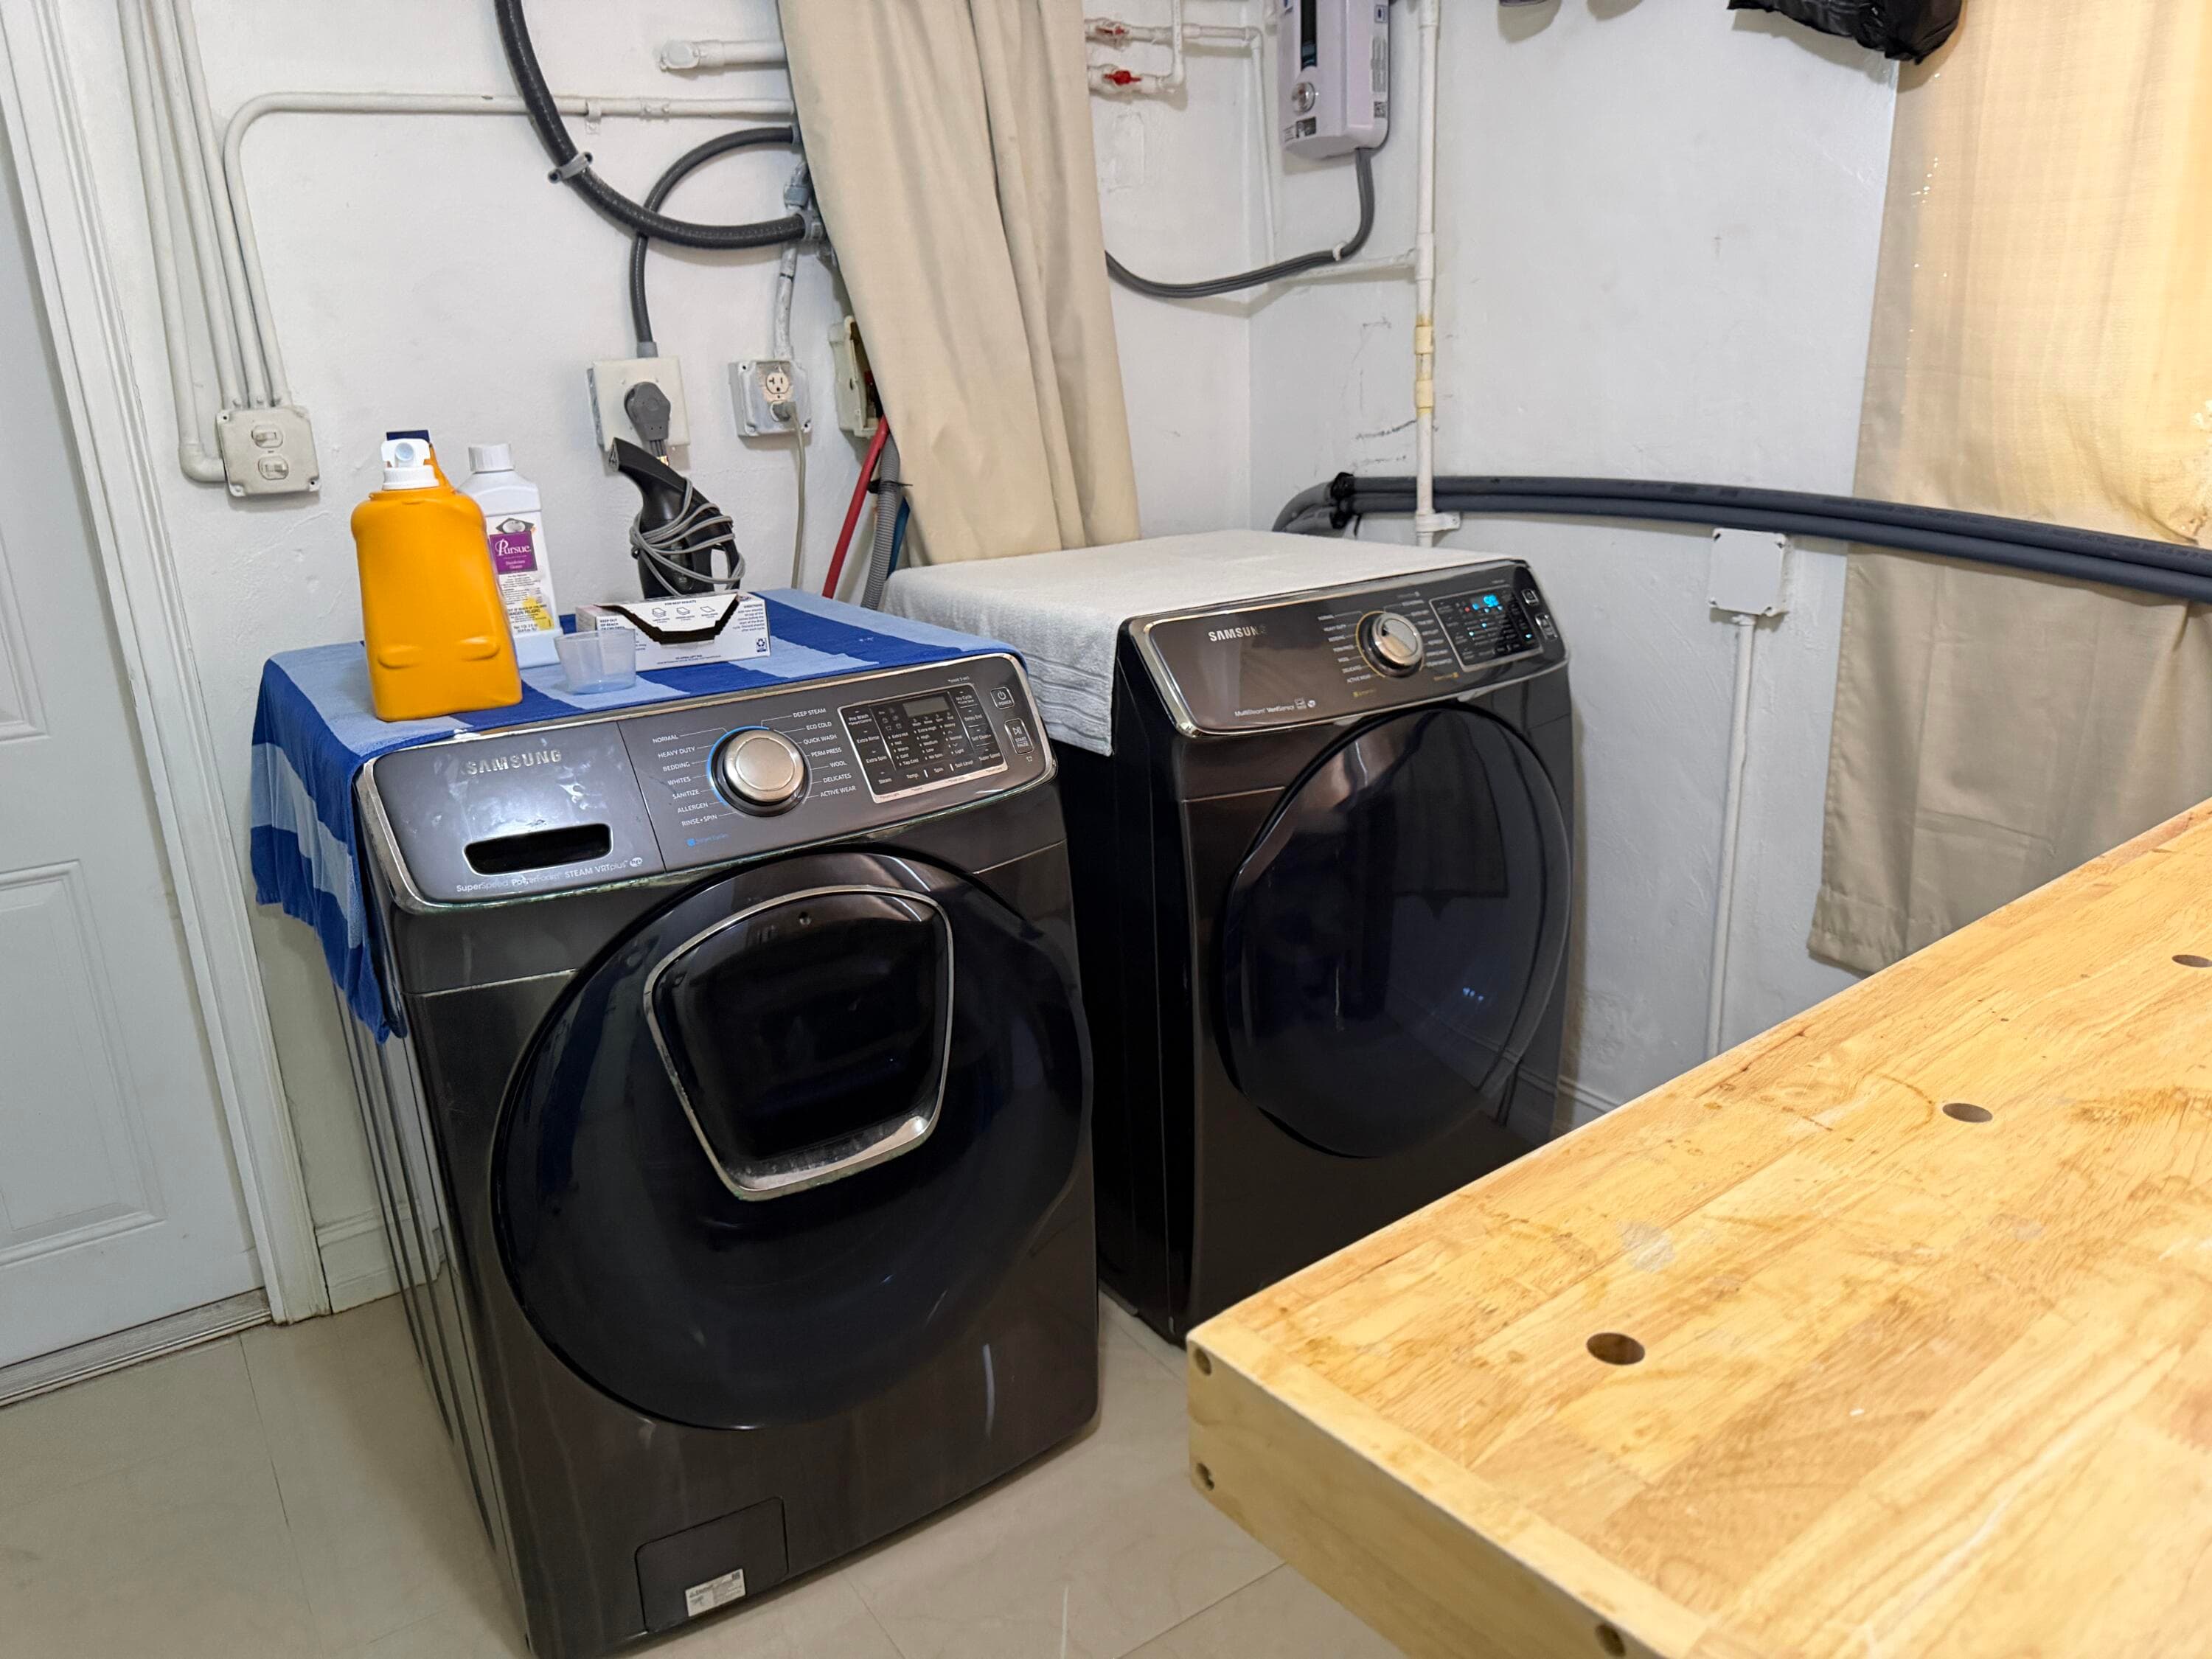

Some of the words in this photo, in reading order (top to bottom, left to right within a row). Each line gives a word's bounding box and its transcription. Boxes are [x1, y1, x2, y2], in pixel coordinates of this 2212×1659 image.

[807, 708, 827, 716] STEAM
[653, 734, 679, 743] NORMAL
[803, 737, 821, 745] QUICK
[820, 734, 838, 742] WASH
[679, 746, 696, 754] DUTY
[810, 749, 826, 757] PERM
[466, 749, 562, 775] SAMSUNG
[663, 761, 691, 772] BEDDING
[667, 776, 692, 786] WHITES
[823, 773, 852, 783] DELICATES
[672, 789, 700, 799] SANITIZE
[821, 789, 840, 797] ACTIVE
[840, 785, 856, 793] WEAR
[678, 802, 709, 813] ALLERGEN
[565, 867, 593, 878] STEAM
